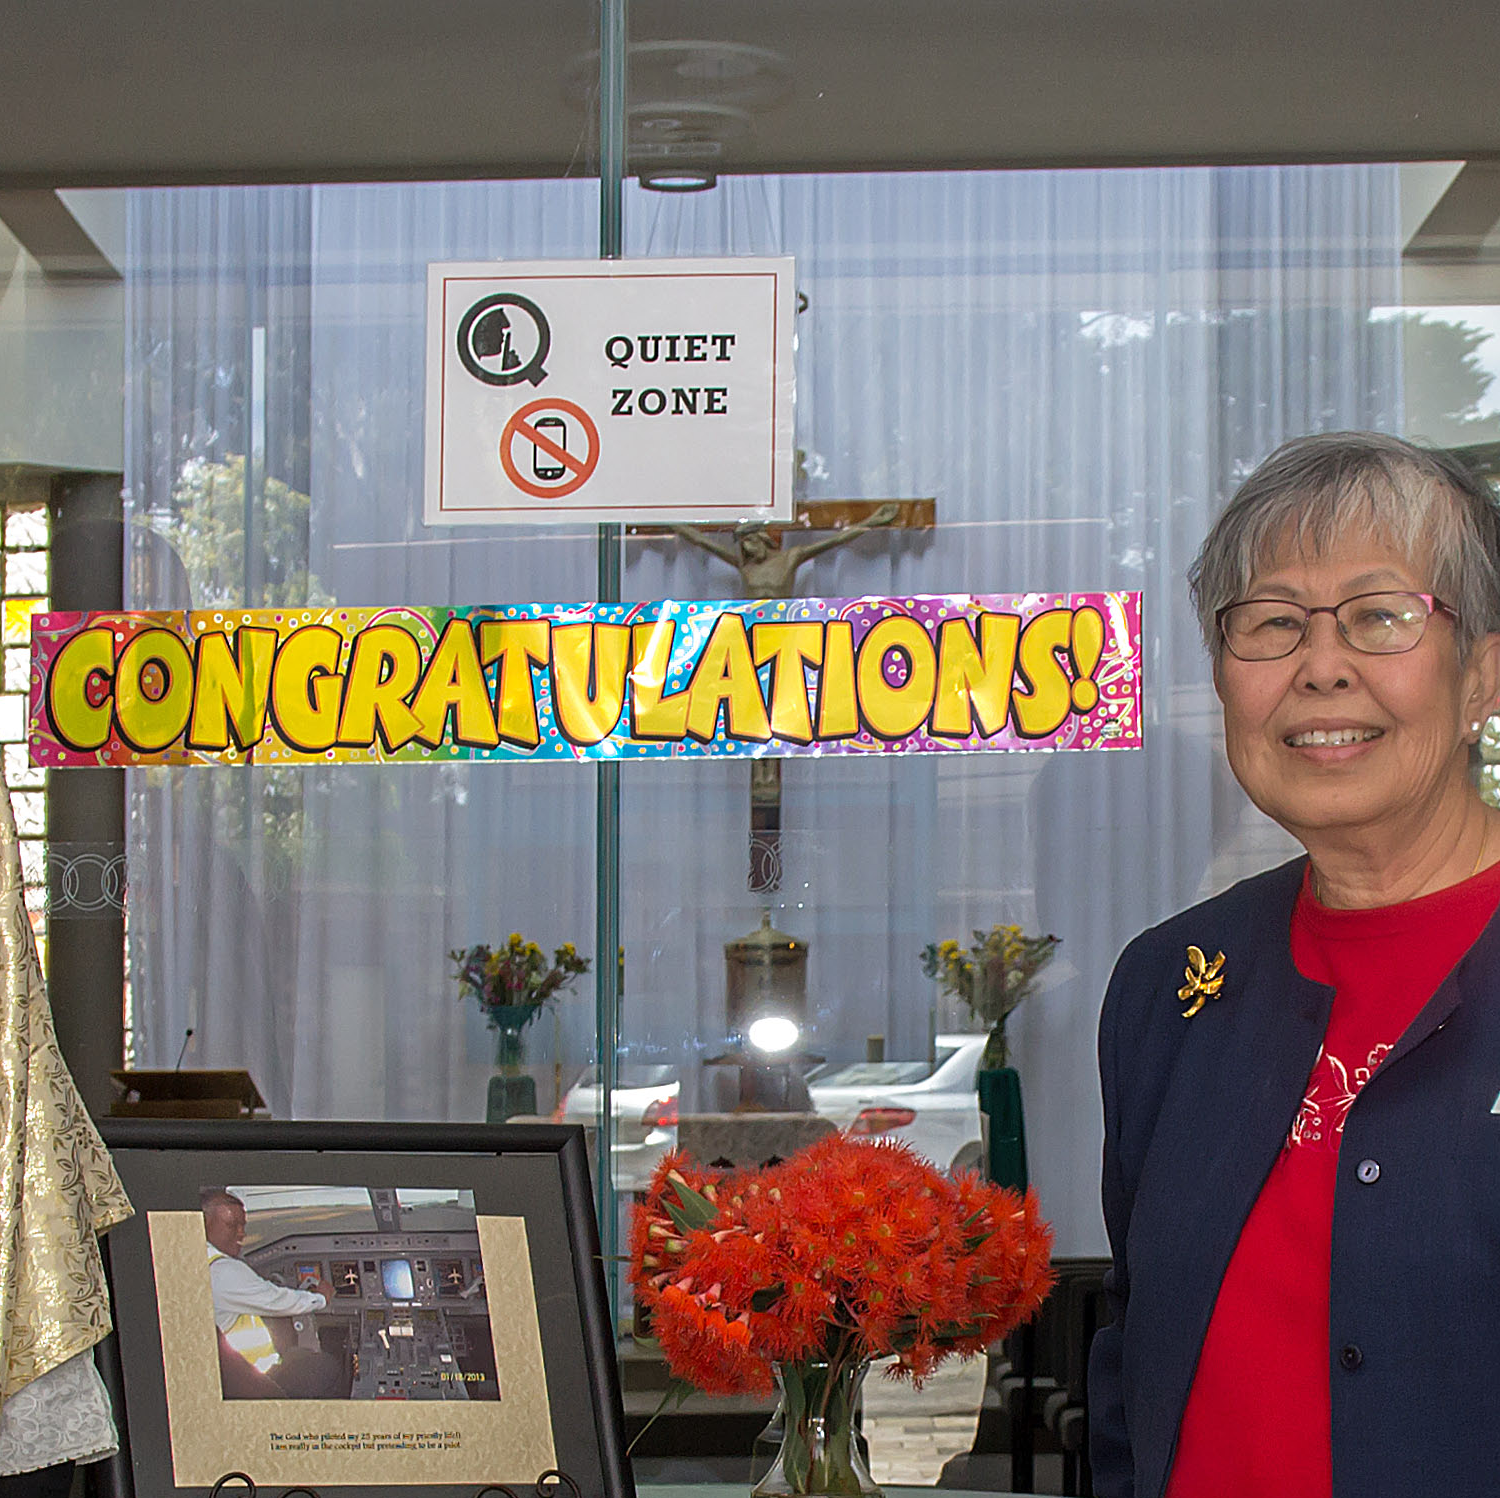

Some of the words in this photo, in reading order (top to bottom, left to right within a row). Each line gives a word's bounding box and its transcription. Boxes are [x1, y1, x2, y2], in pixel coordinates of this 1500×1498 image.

[604, 333, 737, 368] QUIET
[611, 387, 729, 416] ZONE
[48, 606, 1107, 754] CONGRATULATIONS!
[321, 1442, 333, 1450] the
[362, 1442, 375, 1450] but
[427, 1441, 436, 1449] be
